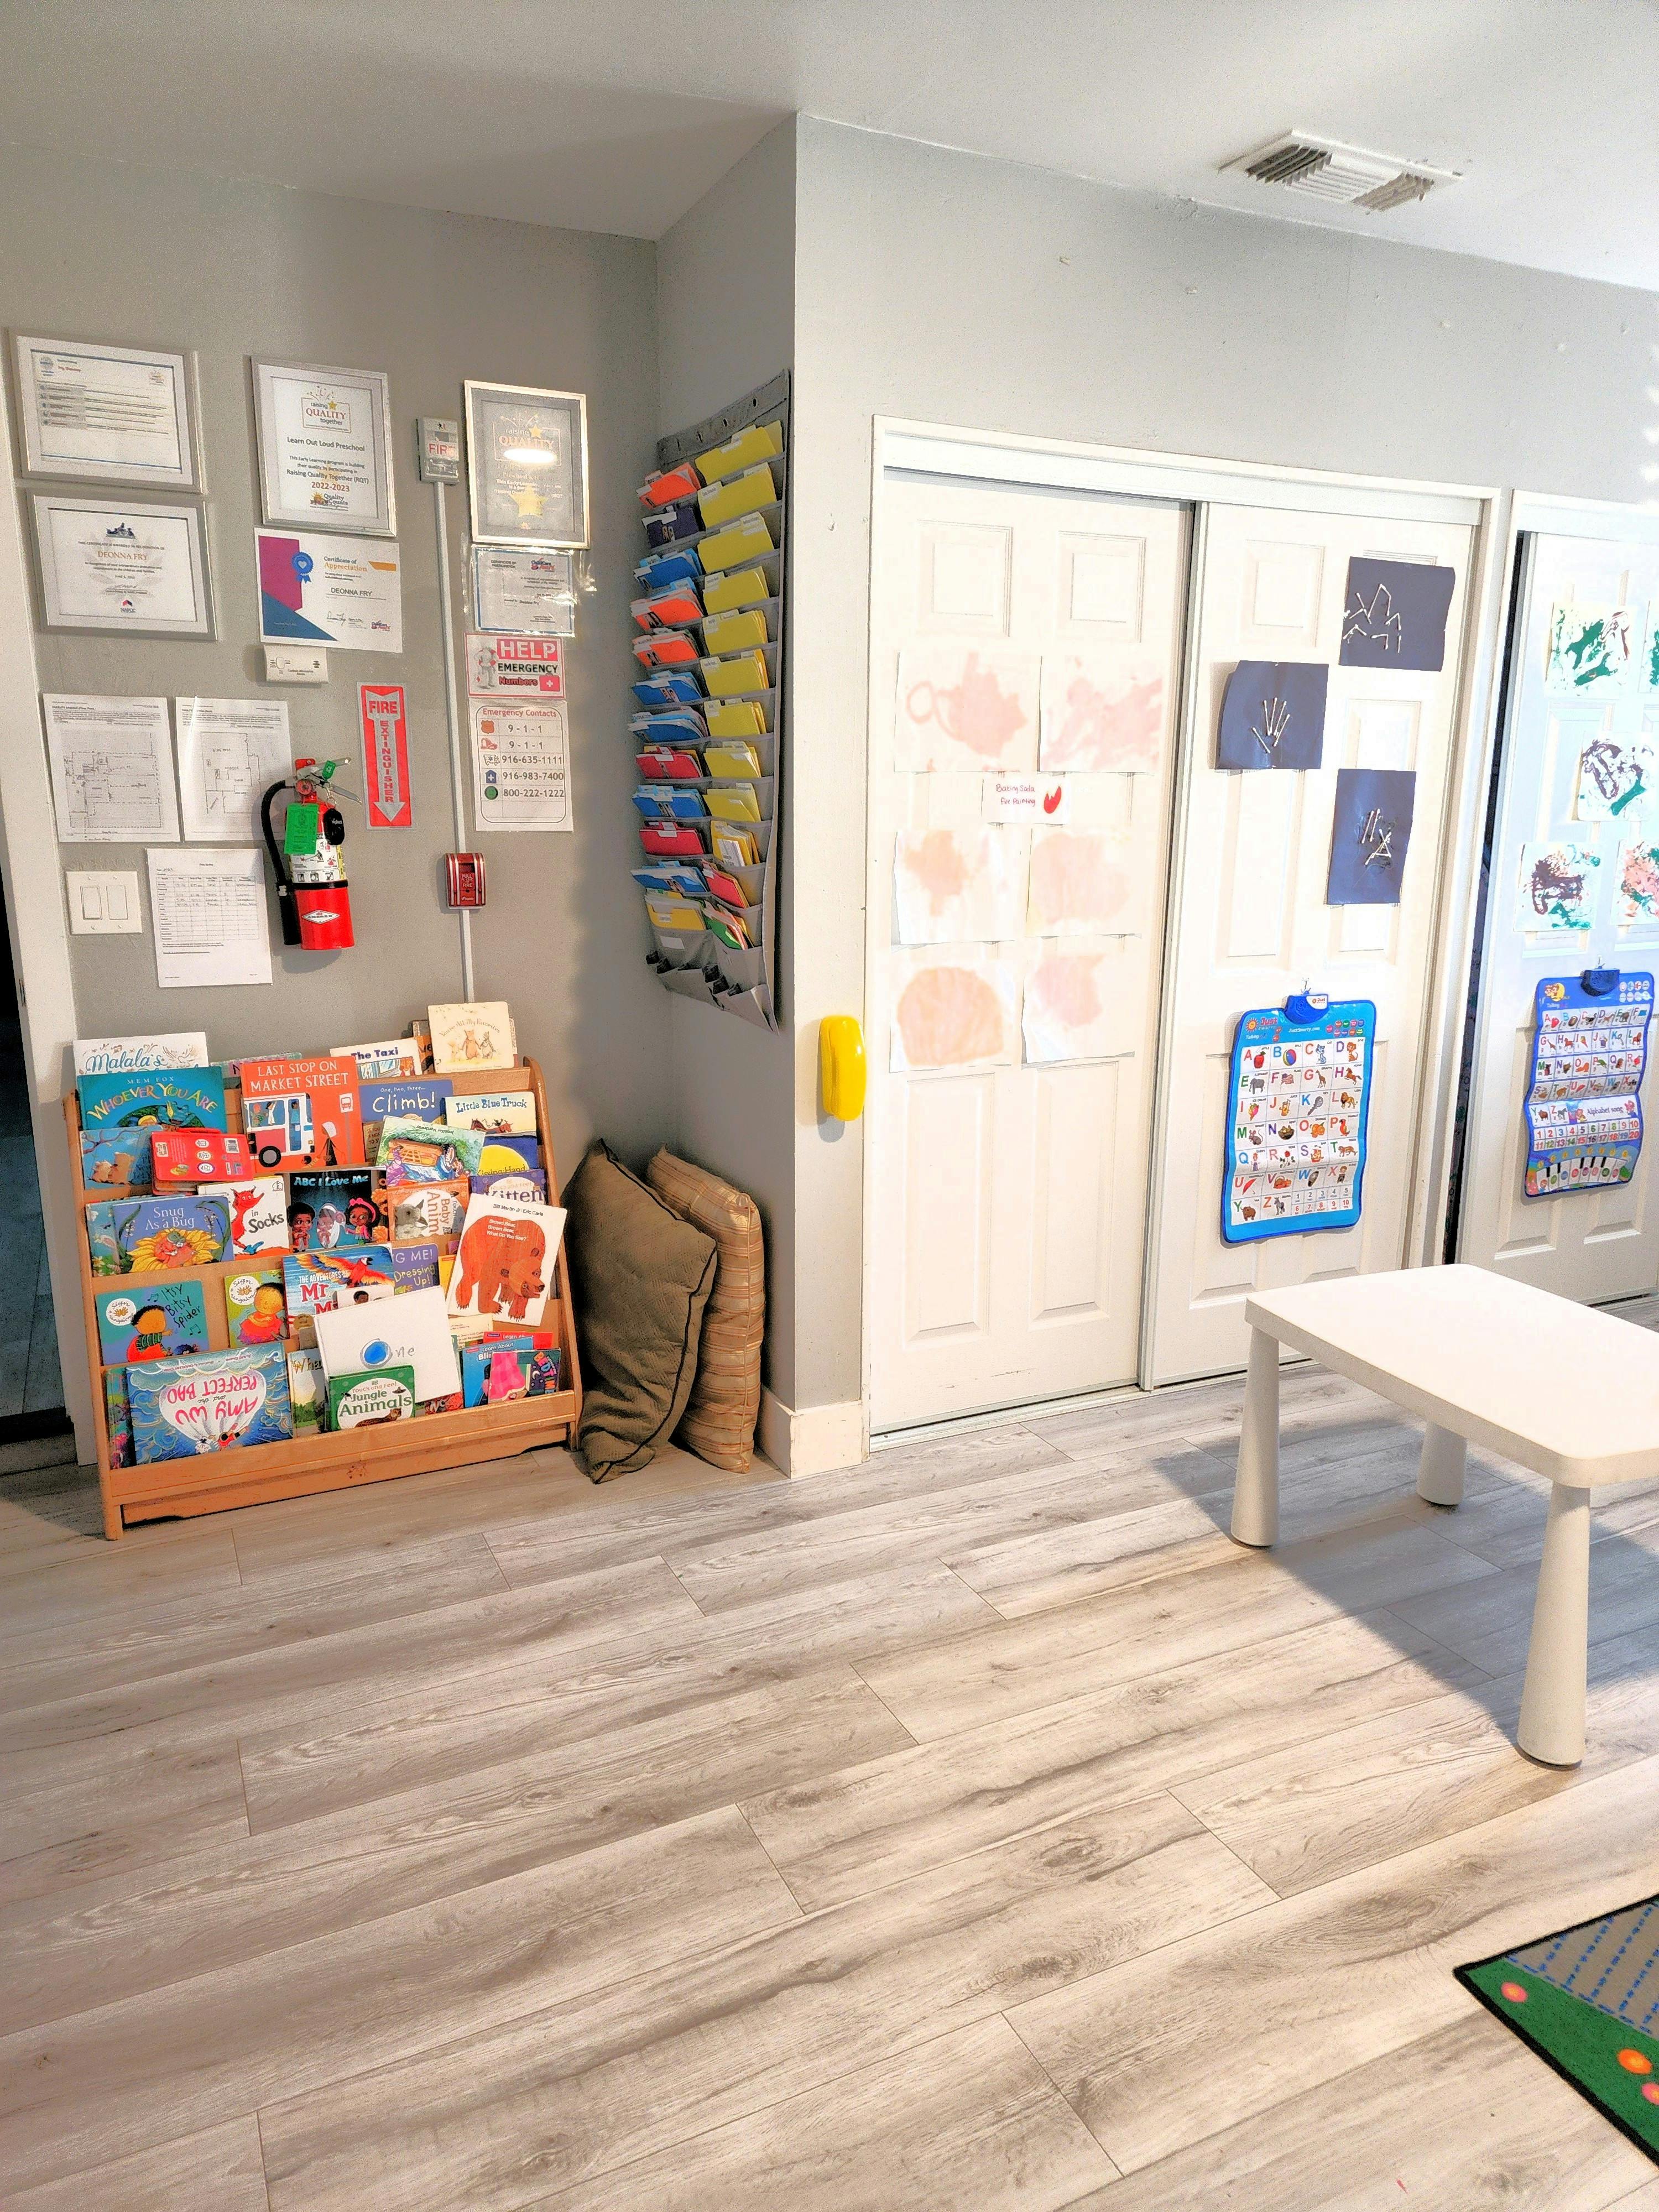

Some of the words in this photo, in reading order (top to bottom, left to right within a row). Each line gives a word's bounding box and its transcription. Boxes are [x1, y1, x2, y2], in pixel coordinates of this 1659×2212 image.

[306, 408, 346, 419] QUALITY
[336, 442, 365, 451] Preschool
[429, 443, 456, 456] FIRE
[286, 469, 306, 477] Raising
[311, 482, 349, 492] 2022-2023
[97, 551, 132, 560] DEONNA
[324, 562, 368, 572] Appreciation
[331, 587, 358, 596] DEONNA
[500, 641, 556, 659] HELP
[498, 663, 557, 673] EMERGENCY
[499, 676, 538, 686] Numbers
[369, 701, 398, 714] FIRE
[483, 708, 523, 717] Emergency
[508, 724, 514, 733] 9
[509, 740, 515, 749] 9
[380, 721, 394, 802] EXTINGUISHER
[502, 755, 562, 765] 916-635-1111
[503, 772, 564, 780] 916-983-7400
[503, 788, 565, 797] 800-222-1222
[996, 784, 1018, 794] Baking
[1273, 1046, 1282, 1057] B
[1305, 1043, 1314, 1055] C
[1336, 1041, 1344, 1052] D
[351, 1051, 372, 1061] The
[374, 1047, 399, 1057] Taxi
[1244, 1050, 1253, 1061] A
[85, 1048, 168, 1073] Malala's
[258, 1065, 284, 1077] LAST
[289, 1062, 316, 1074] STOP
[319, 1060, 337, 1072] ON
[251, 1077, 301, 1093] MARKET
[305, 1072, 349, 1088] STREET
[87, 1085, 161, 1120] WHOEVER
[156, 1083, 189, 1097] YOU
[186, 1089, 217, 1113] ARE
[372, 1091, 435, 1113] Climb!
[456, 1101, 479, 1113] Little
[481, 1098, 500, 1109] Blue
[500, 1097, 527, 1108] Truck
[1587, 1107, 1610, 1116] Alphabet
[1630, 1120, 1639, 1128] 10
[1629, 1130, 1639, 1139] 20
[504, 1164, 526, 1173] Hand
[294, 1177, 316, 1186] ABC
[318, 1177, 322, 1186] I
[325, 1177, 349, 1186] Love
[352, 1175, 368, 1184] Me
[153, 1207, 184, 1219] Snug
[440, 1198, 451, 1224] Baby
[145, 1220, 160, 1230] As
[173, 1217, 195, 1229] Bug
[248, 1213, 285, 1234] Socks
[411, 1249, 433, 1261] ME!
[299, 1275, 310, 1284] THE
[310, 1271, 341, 1283] ADVENTURES
[394, 1264, 435, 1283] Dressing
[413, 1275, 431, 1287] Up!
[161, 1284, 182, 1301] Itsy
[165, 1296, 192, 1318] Bitsy
[173, 1306, 201, 1329] Spider
[291, 1358, 322, 1374] Wha
[202, 1375, 257, 1397] PERFECT
[167, 1382, 196, 1405] BAO
[212, 1394, 226, 1402] and
[351, 1390, 387, 1402] Jungle
[215, 1396, 259, 1420] AMY
[338, 1395, 411, 1417] Animals
[175, 1406, 208, 1425] WU
